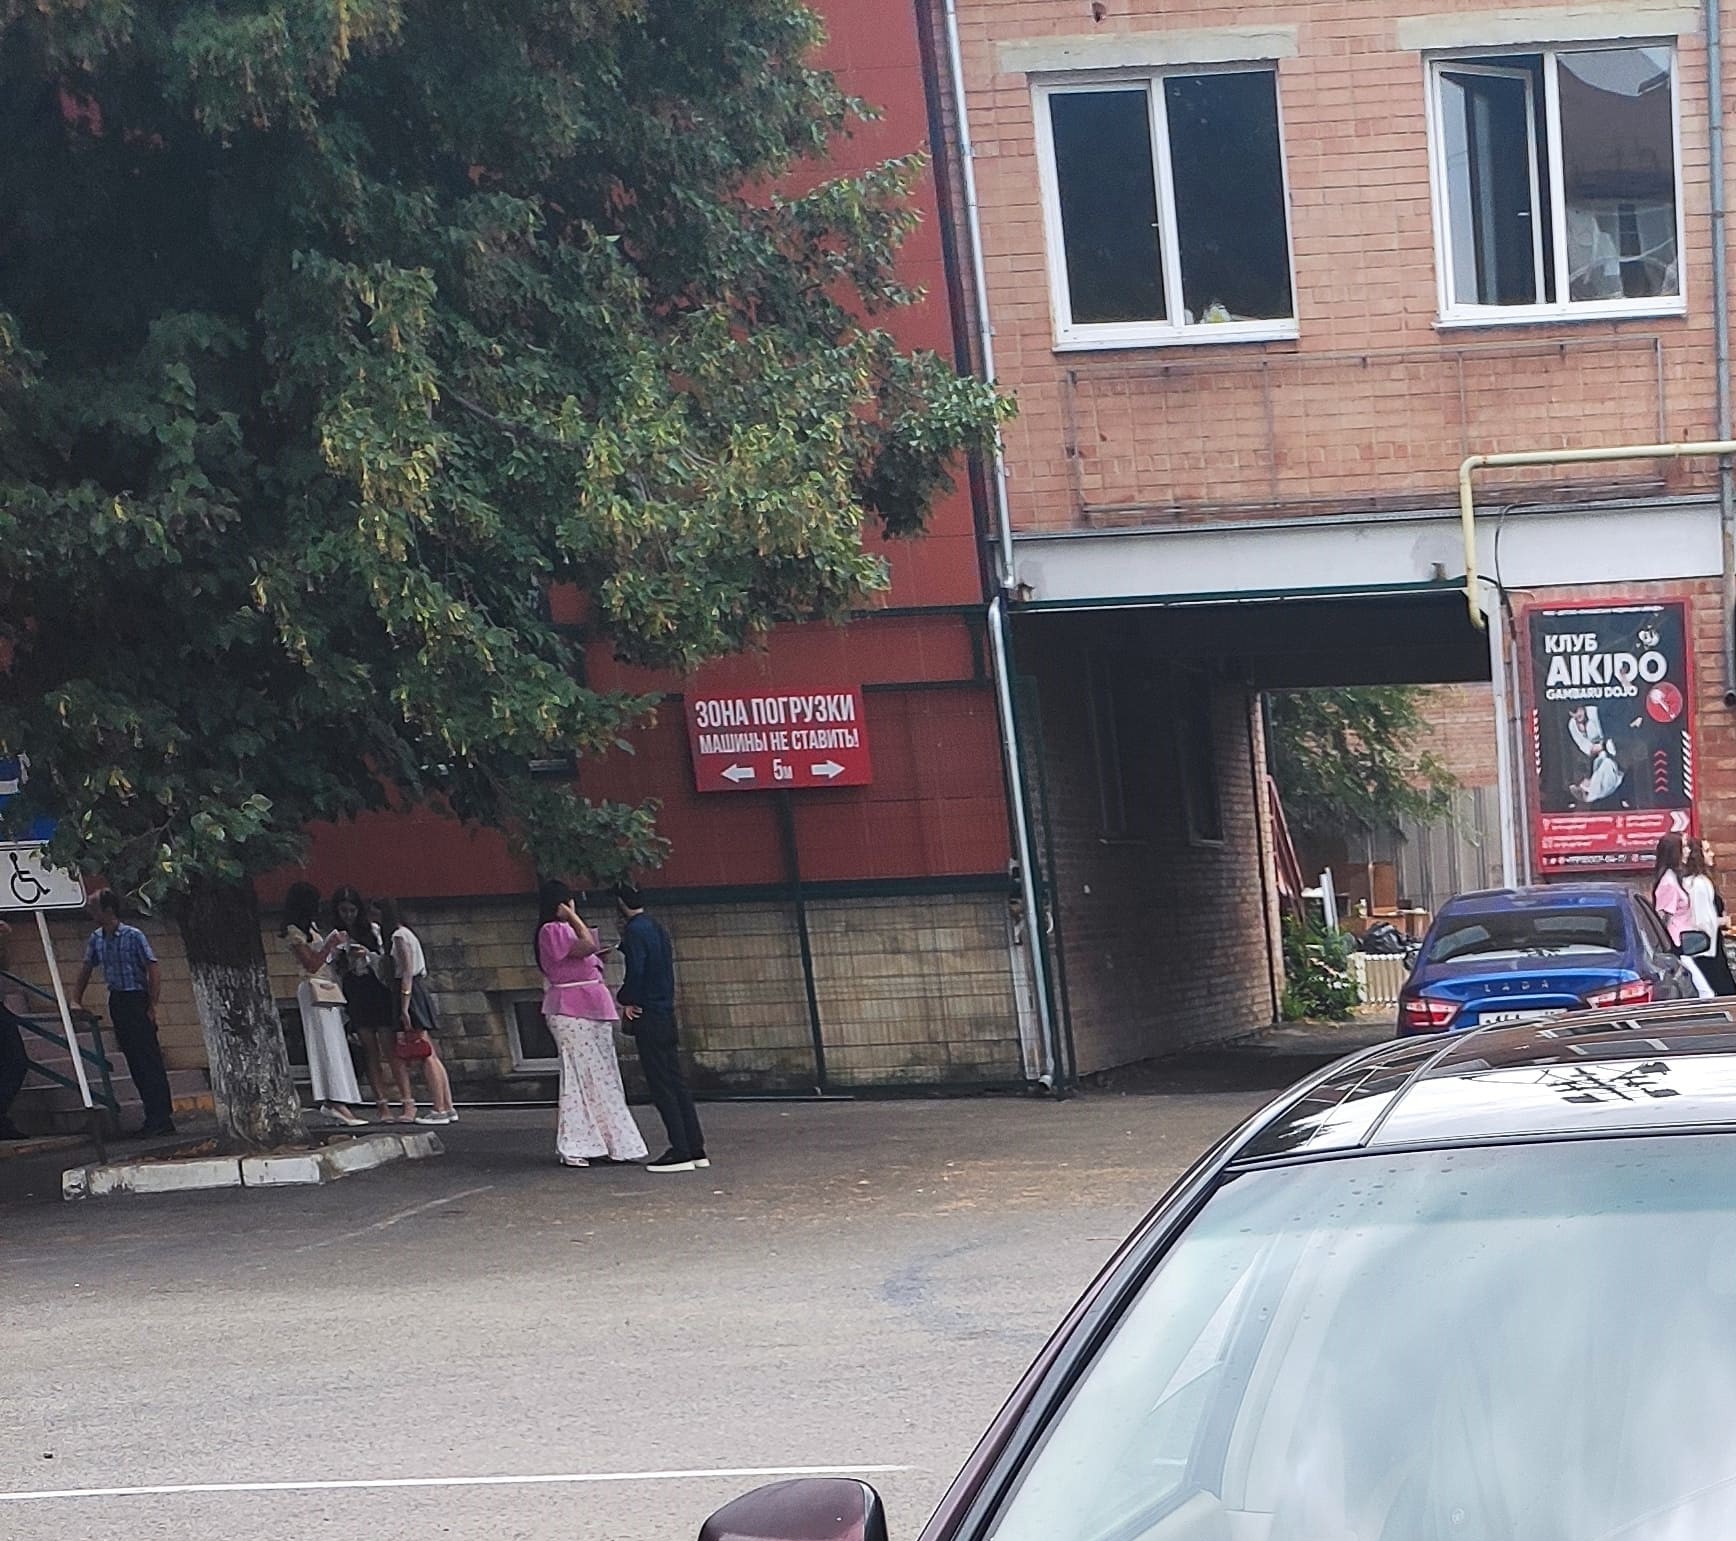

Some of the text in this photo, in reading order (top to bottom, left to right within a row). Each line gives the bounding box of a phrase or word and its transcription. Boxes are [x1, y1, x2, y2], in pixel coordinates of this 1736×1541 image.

[1544, 633, 1598, 653] КЛУБ
[1546, 650, 1667, 686] AIKIDO
[1604, 685, 1638, 699] DOJO
[694, 694, 856, 728] ЗОНА ПОГРУЗКИ
[699, 728, 860, 755] МАШИНЫ НЕ СТАВИТЬ!
[772, 758, 794, 780] 5м
